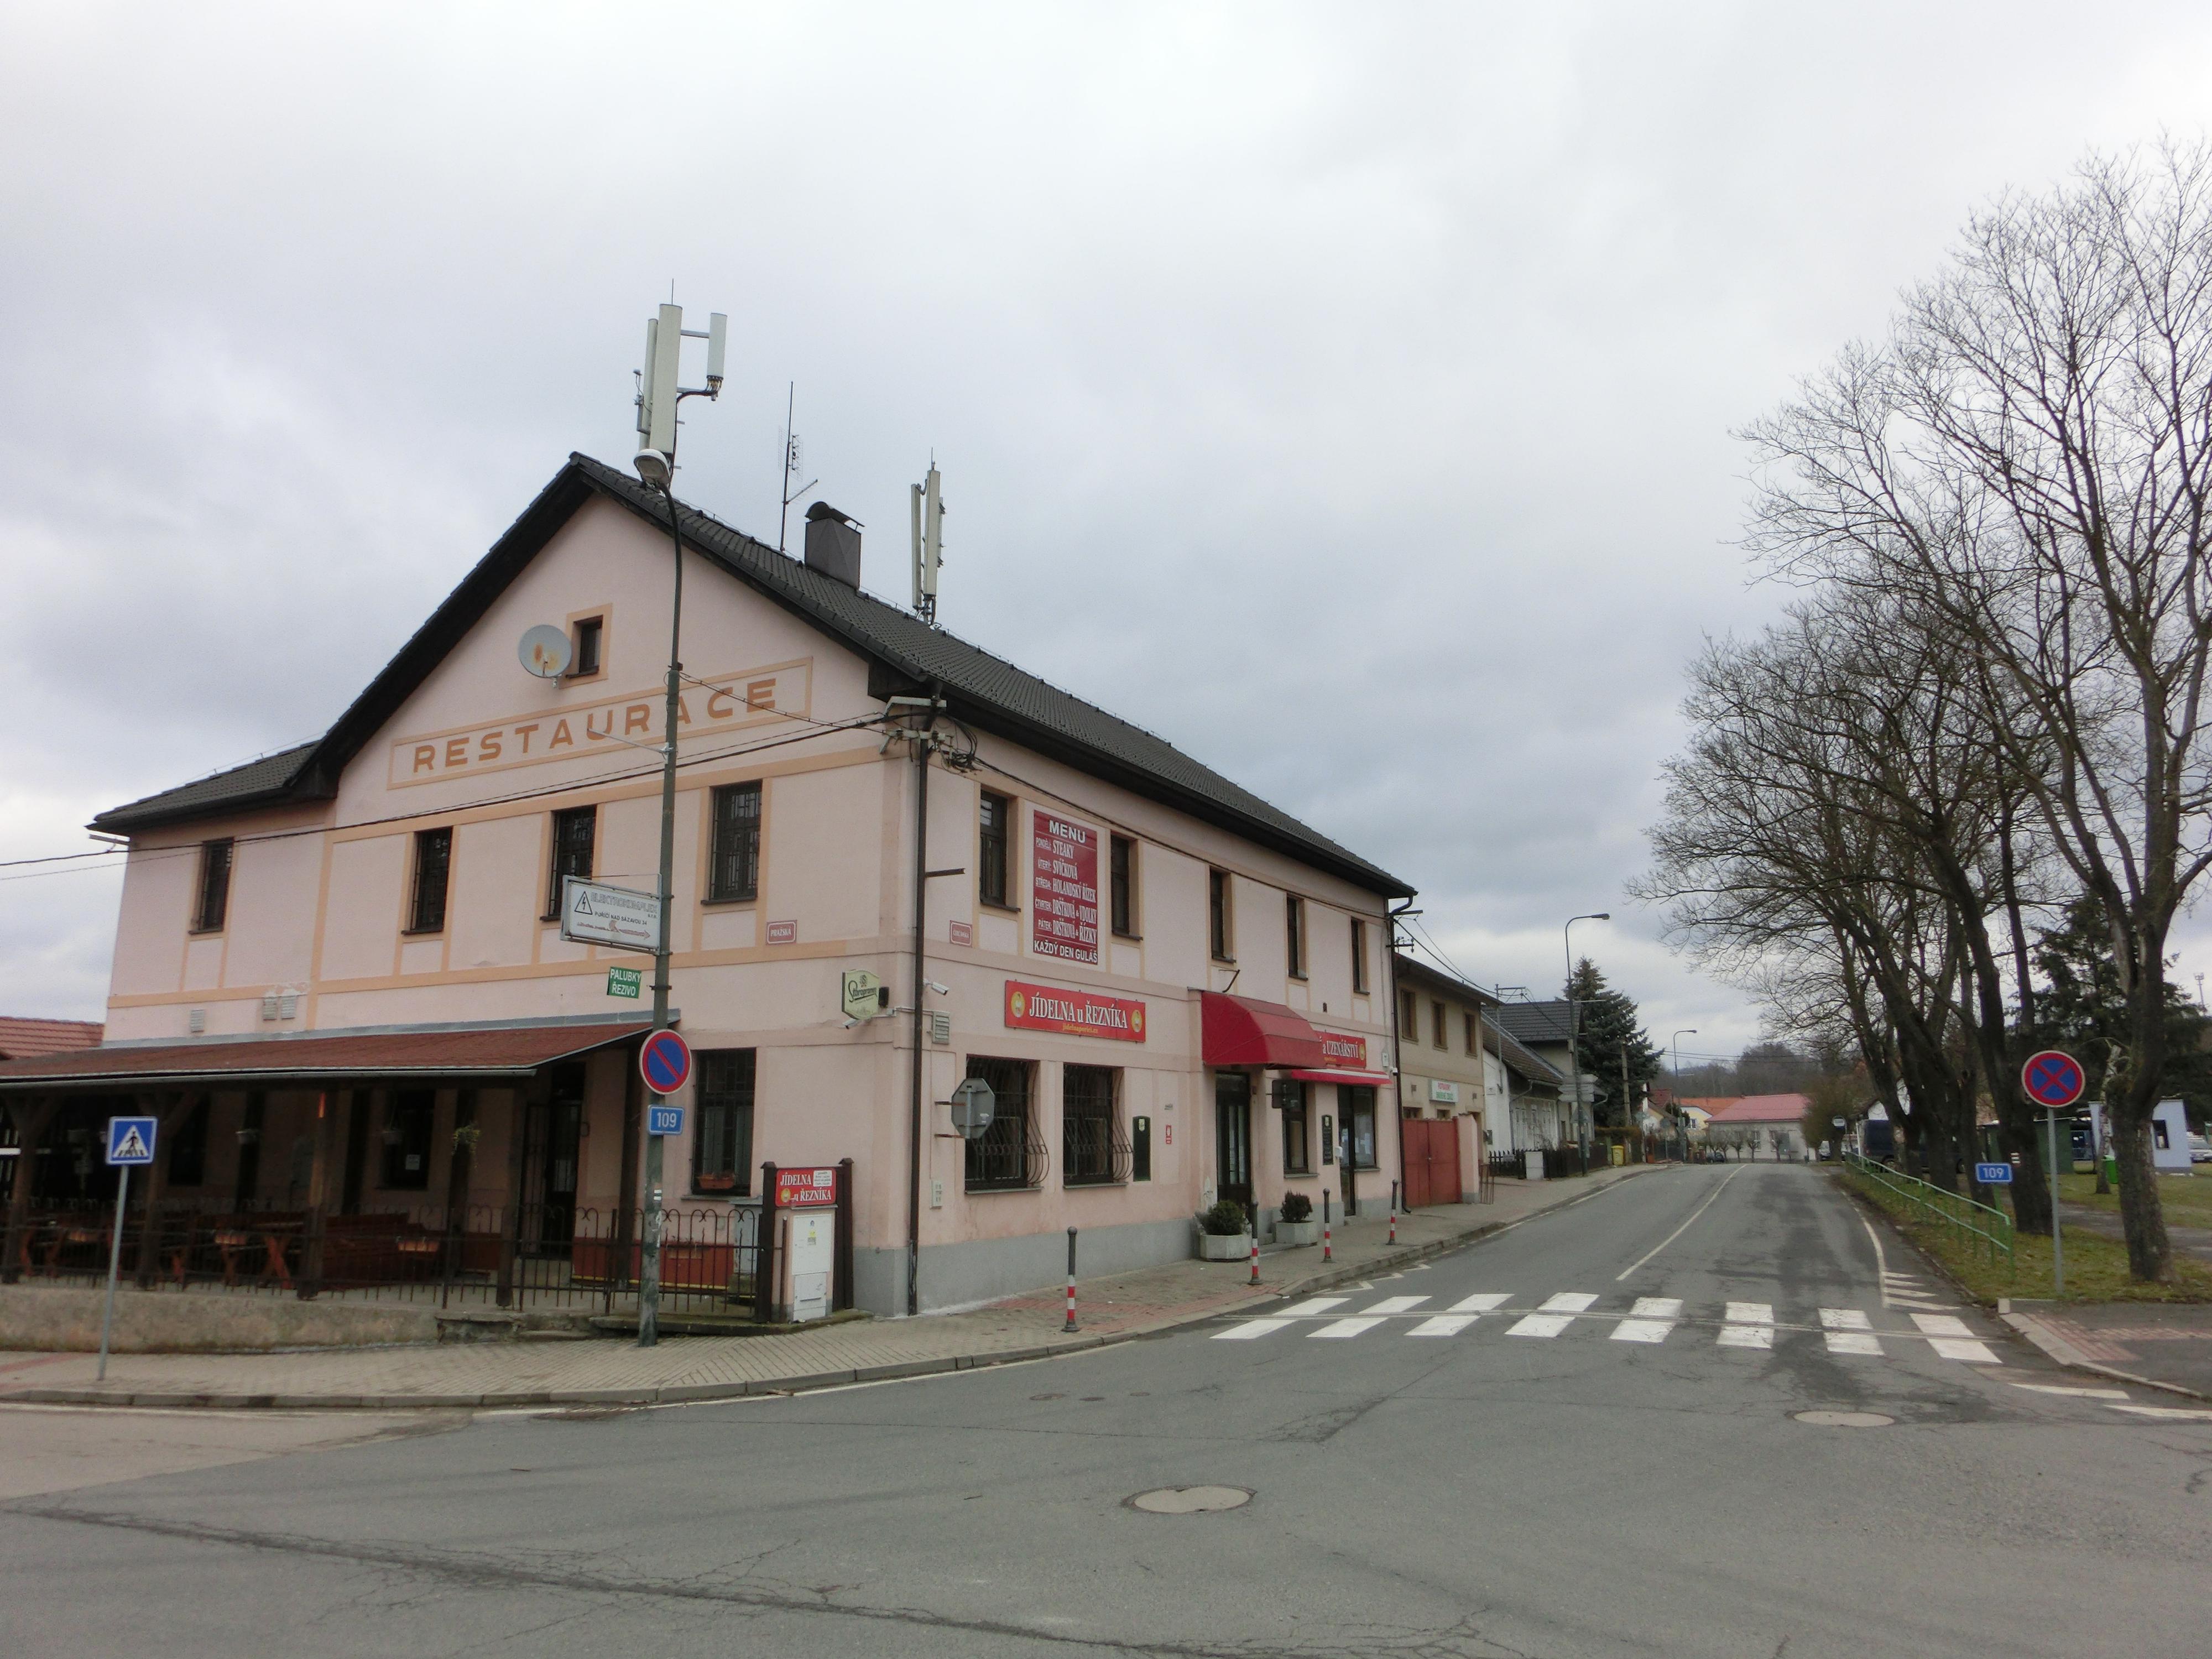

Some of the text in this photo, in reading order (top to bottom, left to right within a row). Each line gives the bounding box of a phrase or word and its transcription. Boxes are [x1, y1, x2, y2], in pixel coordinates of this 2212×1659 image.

[413, 678, 776, 773] RESTAURACE
[1049, 820, 1086, 843] MENU
[1053, 839, 1074, 859] STEAKY
[1053, 858, 1078, 880] SVÍČKOVÁ
[1052, 878, 1082, 899] HOLANDSKÝ
[1082, 883, 1096, 903] ŘÍZEK
[1079, 921, 1097, 945] ŘÍZKY
[1034, 939, 1098, 963] KAŽDÝ DEN GULÁŠ
[610, 968, 641, 983] PALUBKY
[612, 981, 636, 996] ŘEZIVO
[1029, 992, 1128, 1029] JÍDELNA u ŘEZNÍKA
[1322, 1039, 1359, 1058] a UZENÁŘSTVÍ
[657, 1112, 677, 1128] 109
[780, 1172, 812, 1186] JÍDELNA
[1983, 1167, 2004, 1178] 109
[800, 1187, 832, 1202] ŘEZNÍKA
